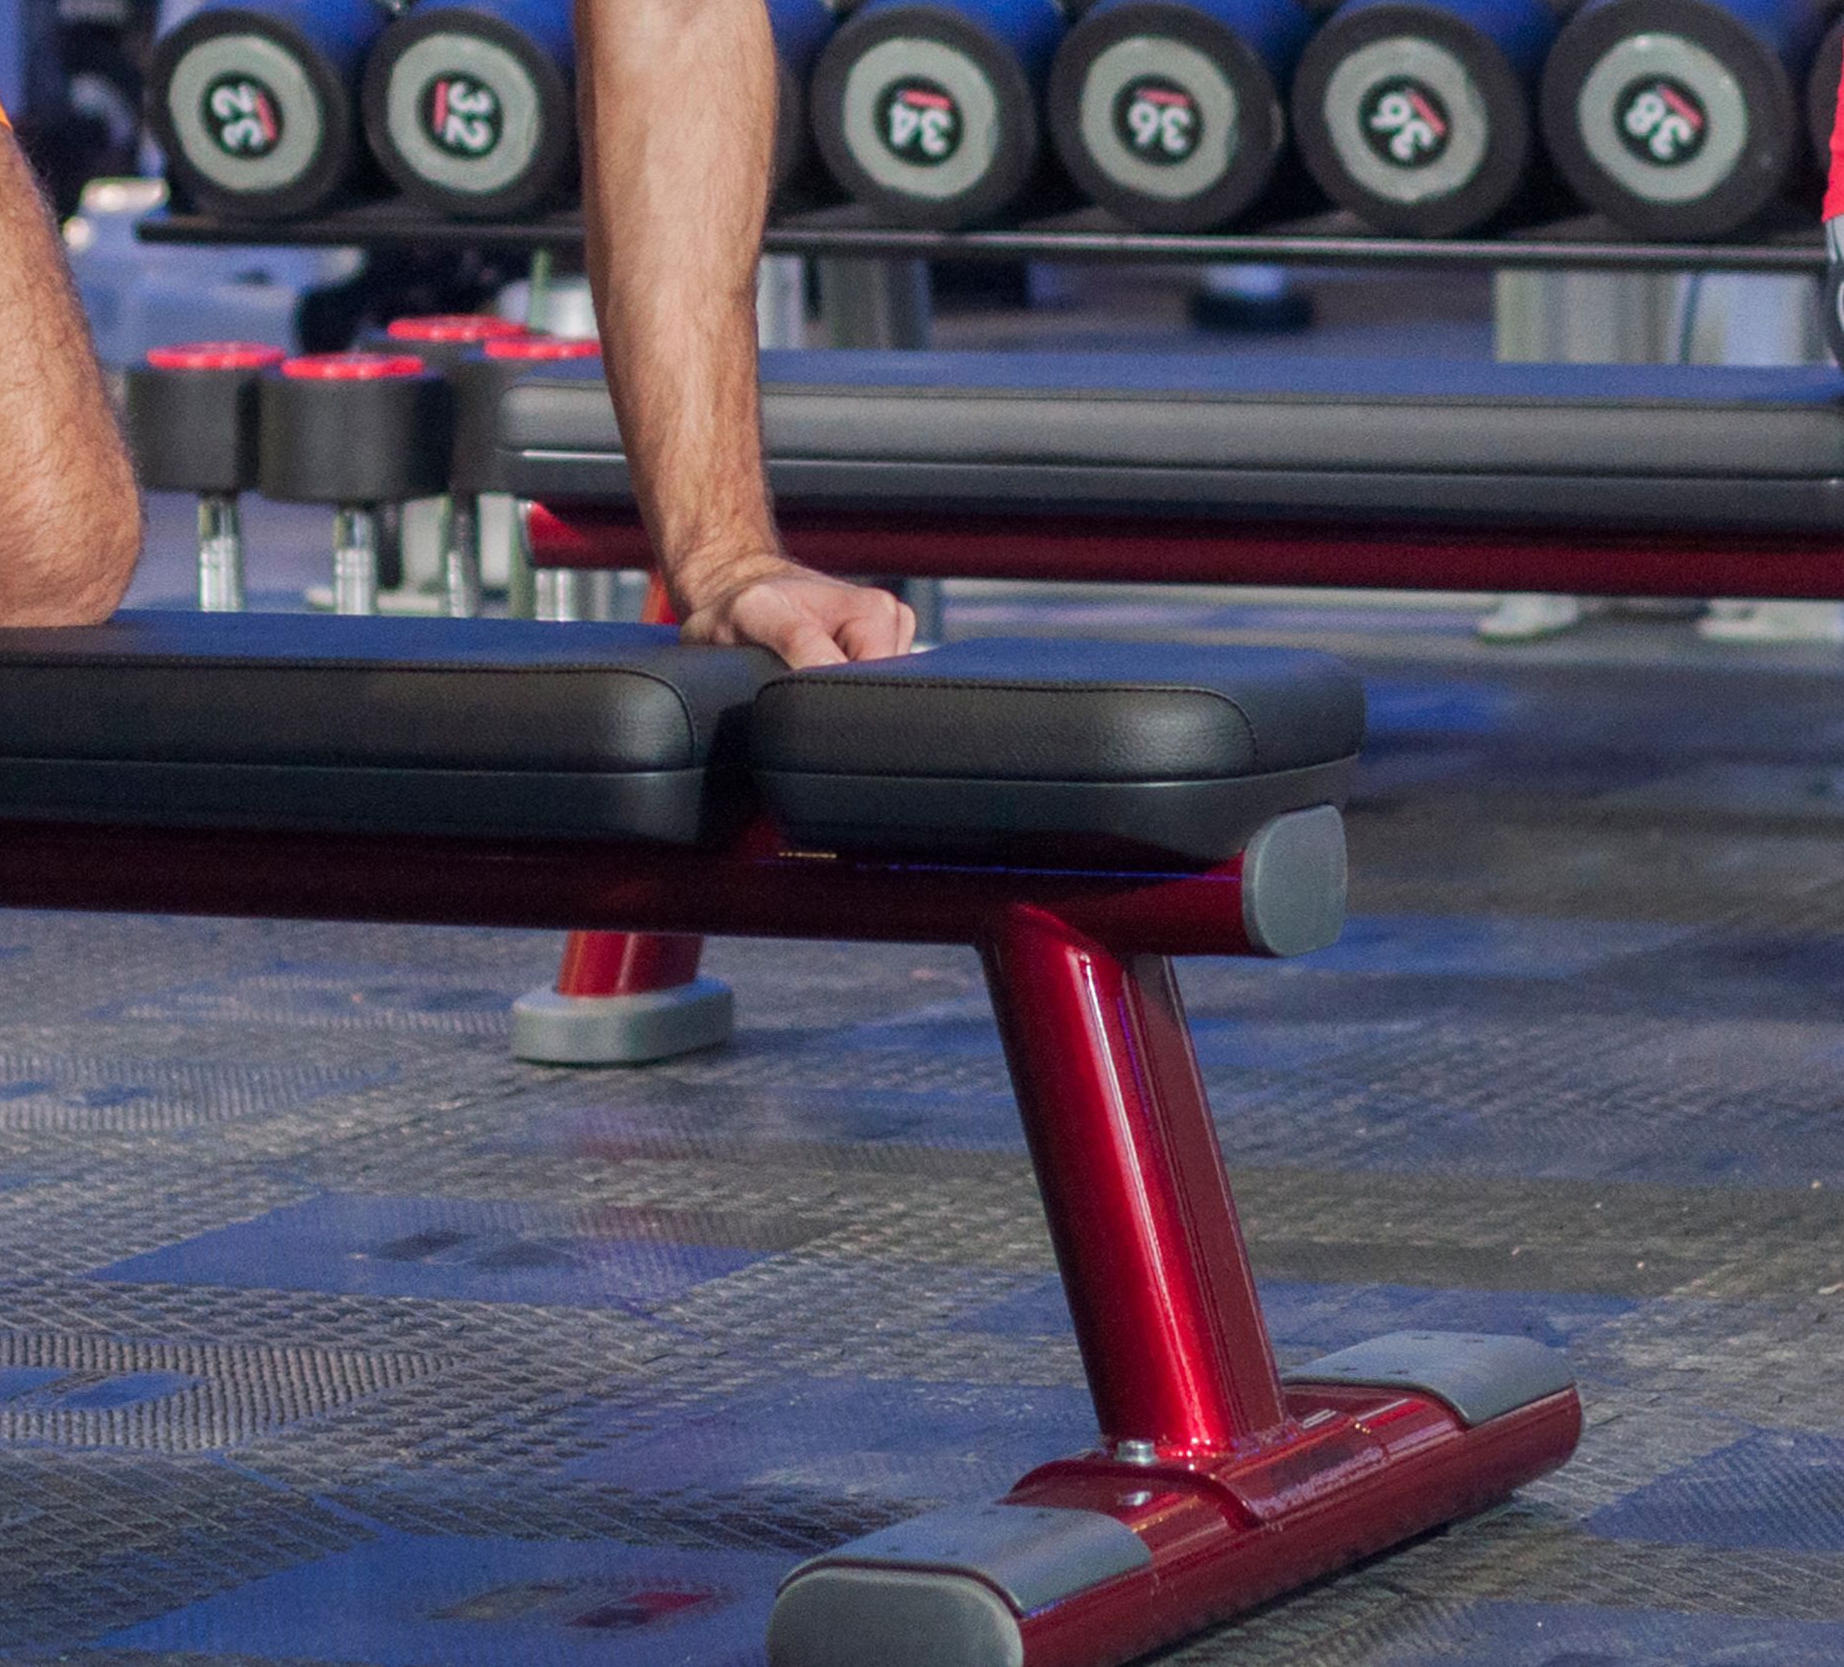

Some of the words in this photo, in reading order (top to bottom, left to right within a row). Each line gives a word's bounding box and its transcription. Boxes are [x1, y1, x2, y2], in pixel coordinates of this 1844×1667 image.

[212, 84, 262, 148] 32
[445, 81, 490, 148] 32
[890, 102, 951, 153] 34
[1129, 101, 1190, 151] 36
[1370, 94, 1432, 158] 36
[1625, 92, 1690, 157] 38
